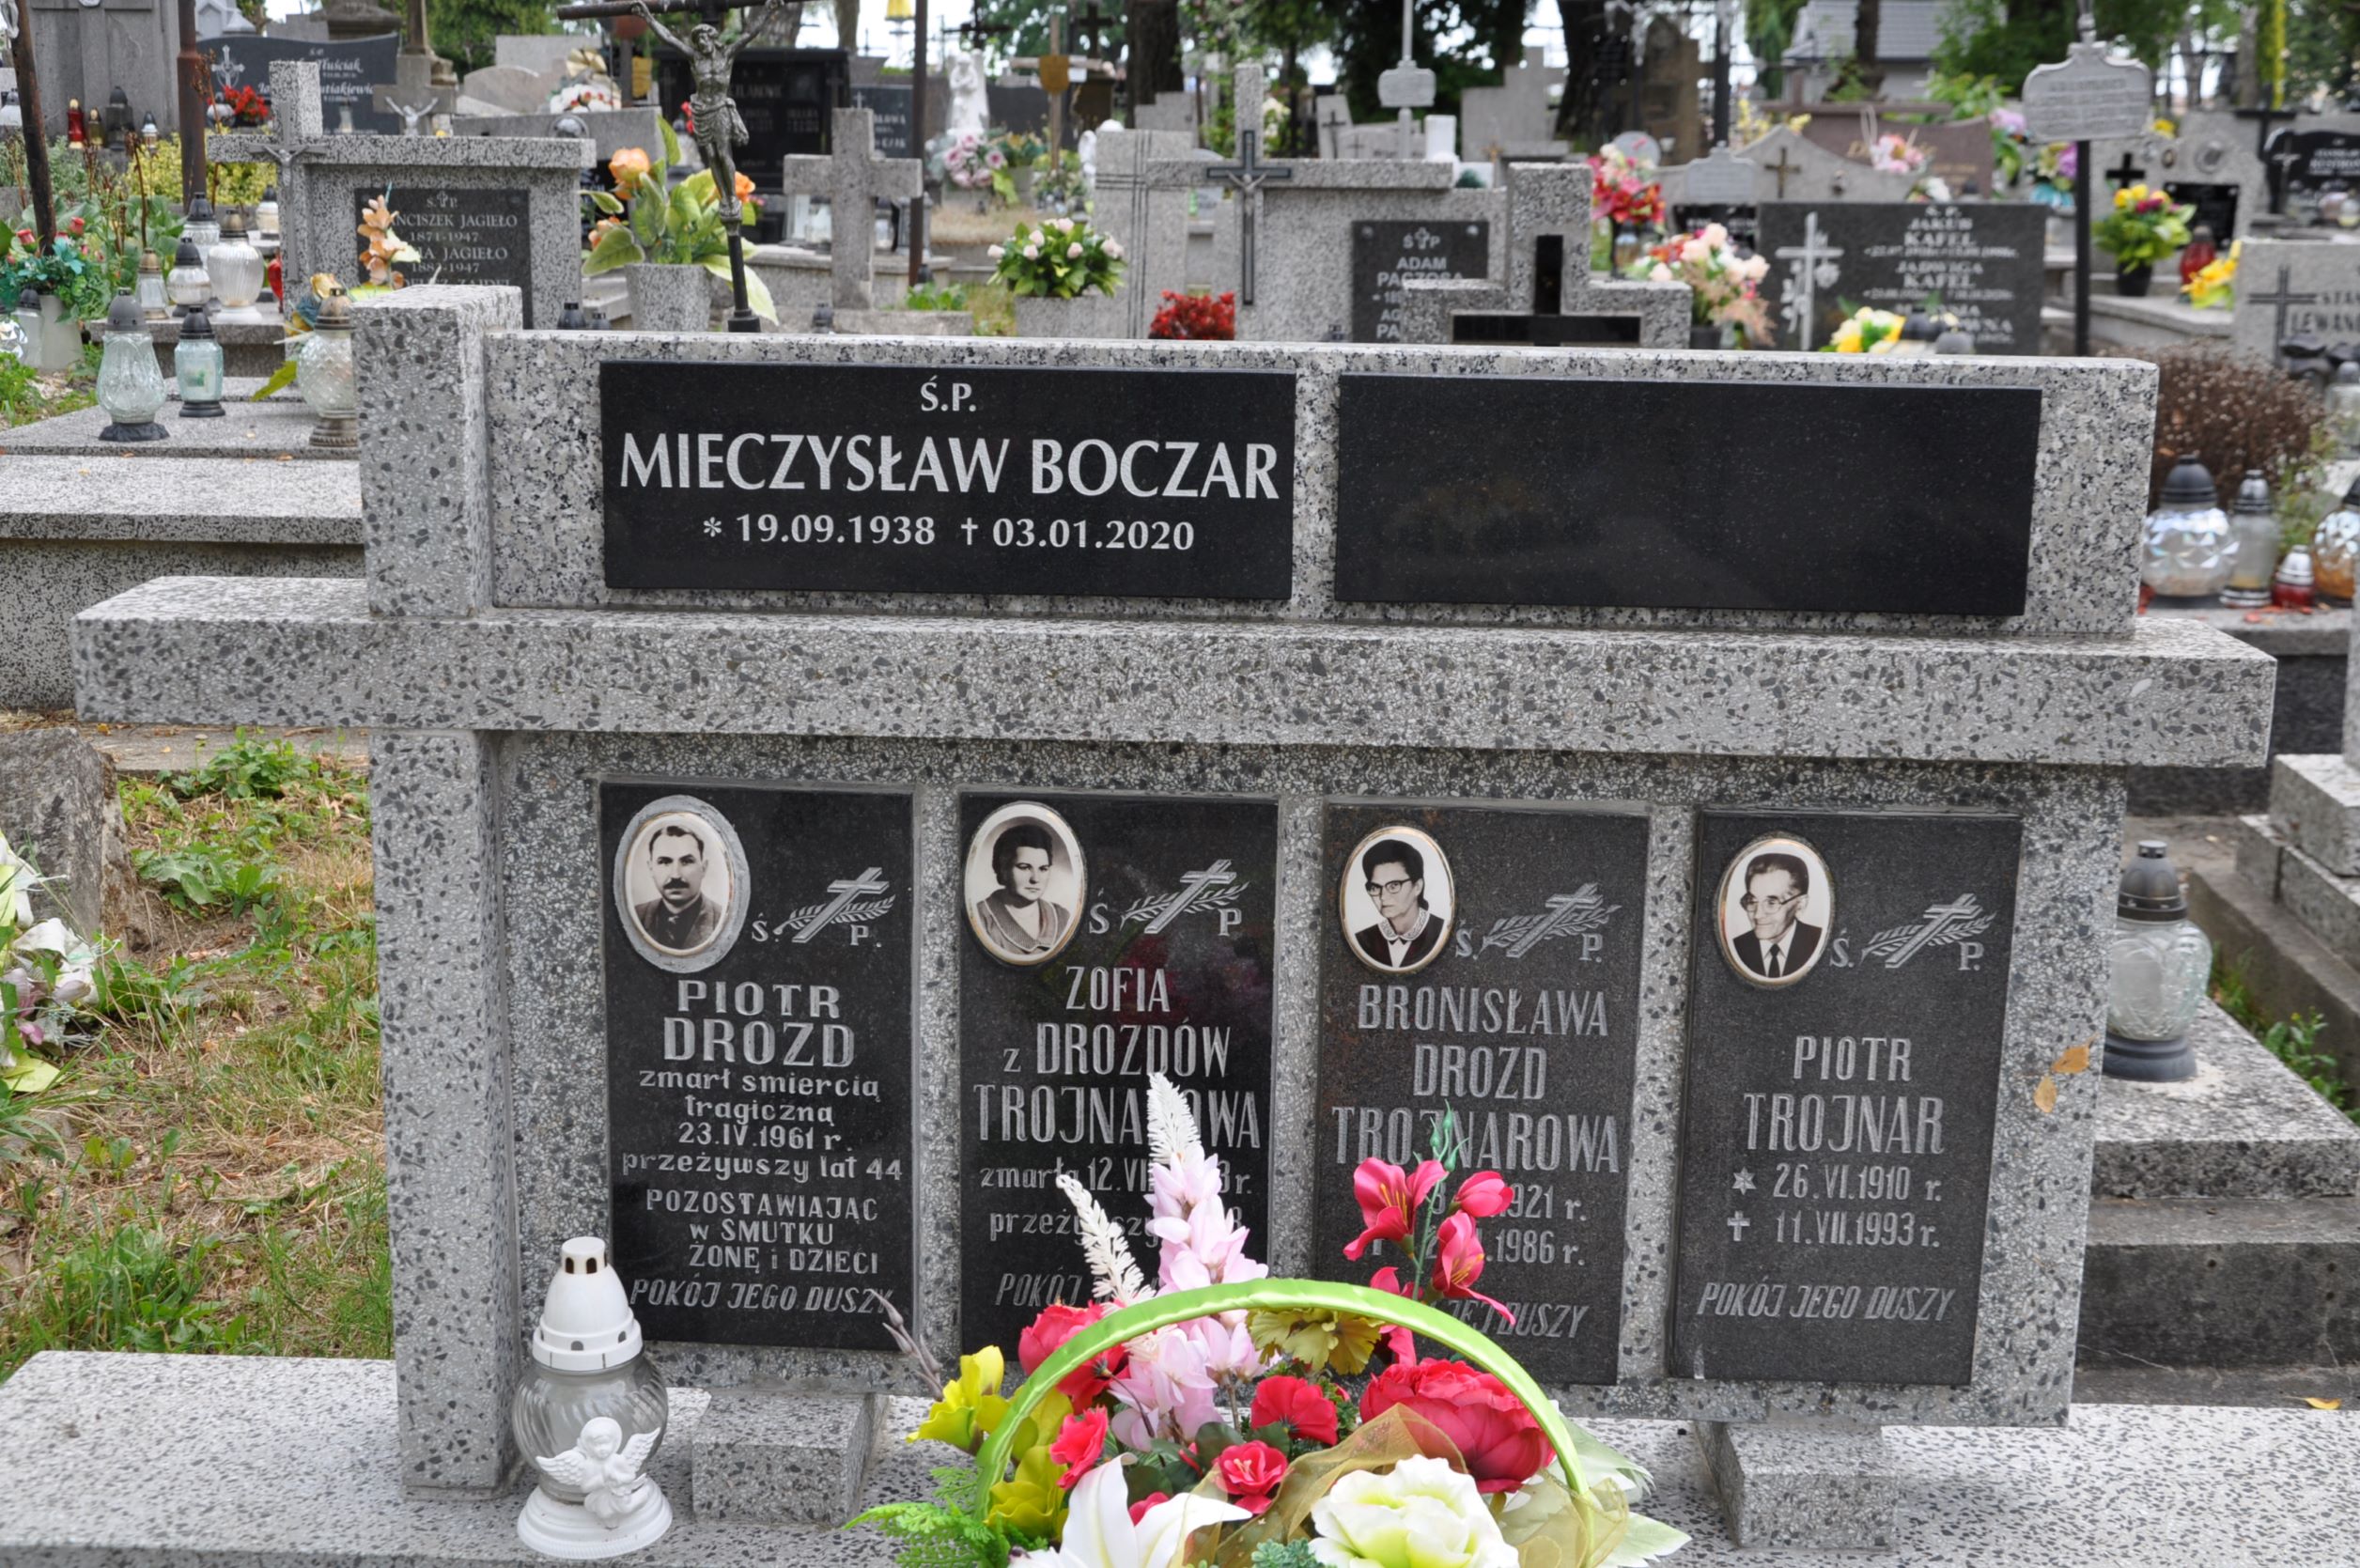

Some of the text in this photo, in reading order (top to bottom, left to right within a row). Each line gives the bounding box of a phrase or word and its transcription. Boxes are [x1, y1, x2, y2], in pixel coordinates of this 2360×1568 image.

[411, 231, 479, 243] 1871-1947
[460, 214, 518, 229] JAGIEŁO
[442, 247, 508, 261] JAGIEŁO
[1396, 256, 1448, 271] ADAM
[620, 431, 1281, 500] MIECZYSŁAW BOCZAR
[736, 513, 1196, 551] 19.09.1938 03.01.2020
[677, 979, 841, 1019] PIOTR
[1065, 966, 1171, 1013] ZOFIA
[1359, 985, 1608, 1036] BRONISŁAWA
[663, 1017, 856, 1068] DROZD
[1036, 1017, 1232, 1079] DROZDÓW
[1793, 1035, 1913, 1082] PIOTR
[640, 1068, 731, 1091] zmarł
[1413, 1044, 1547, 1100] DROZD
[685, 1094, 836, 1127] tragiczną
[973, 1084, 1261, 1149] TROJNAOWA
[1744, 1093, 1945, 1155] TROJNAR
[678, 1122, 815, 1150] 23.IV.1961
[623, 1151, 903, 1184] przeżywszy lat 44
[1773, 1163, 1911, 1201] 26.VI.1910
[645, 1188, 878, 1224] POZOSTAWIAJĄC
[721, 1219, 834, 1246] SMUTKU
[1777, 1211, 1915, 1247] 11.VII.1993
[630, 1272, 722, 1309] POKÓJ
[727, 1281, 799, 1312] JEGO
[1697, 1275, 1956, 1322] POKÓJ JEGO DUSZY
